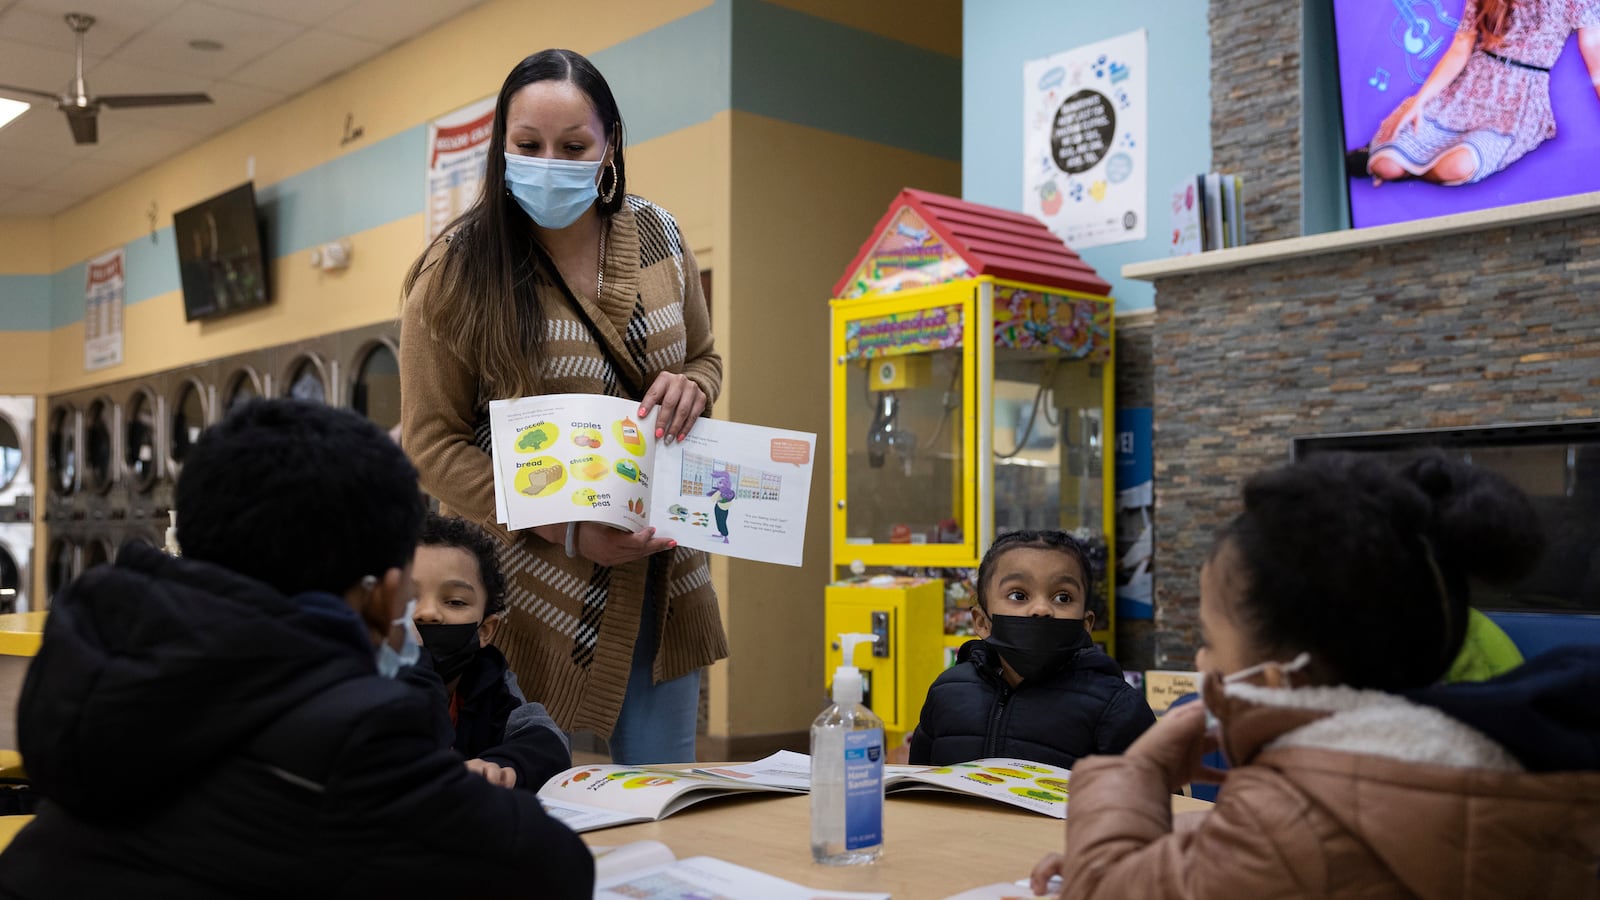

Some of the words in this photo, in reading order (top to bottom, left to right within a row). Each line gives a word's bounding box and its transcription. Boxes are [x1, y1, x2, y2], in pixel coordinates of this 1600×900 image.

[516, 420, 545, 433] broccoli
[571, 421, 602, 430] apples
[516, 460, 543, 469] bread
[570, 457, 594, 465] cheese
[587, 494, 611, 502] green
[592, 501, 611, 509] peas
[847, 771, 869, 780] Hand
[847, 779, 879, 790] Sanitizer
